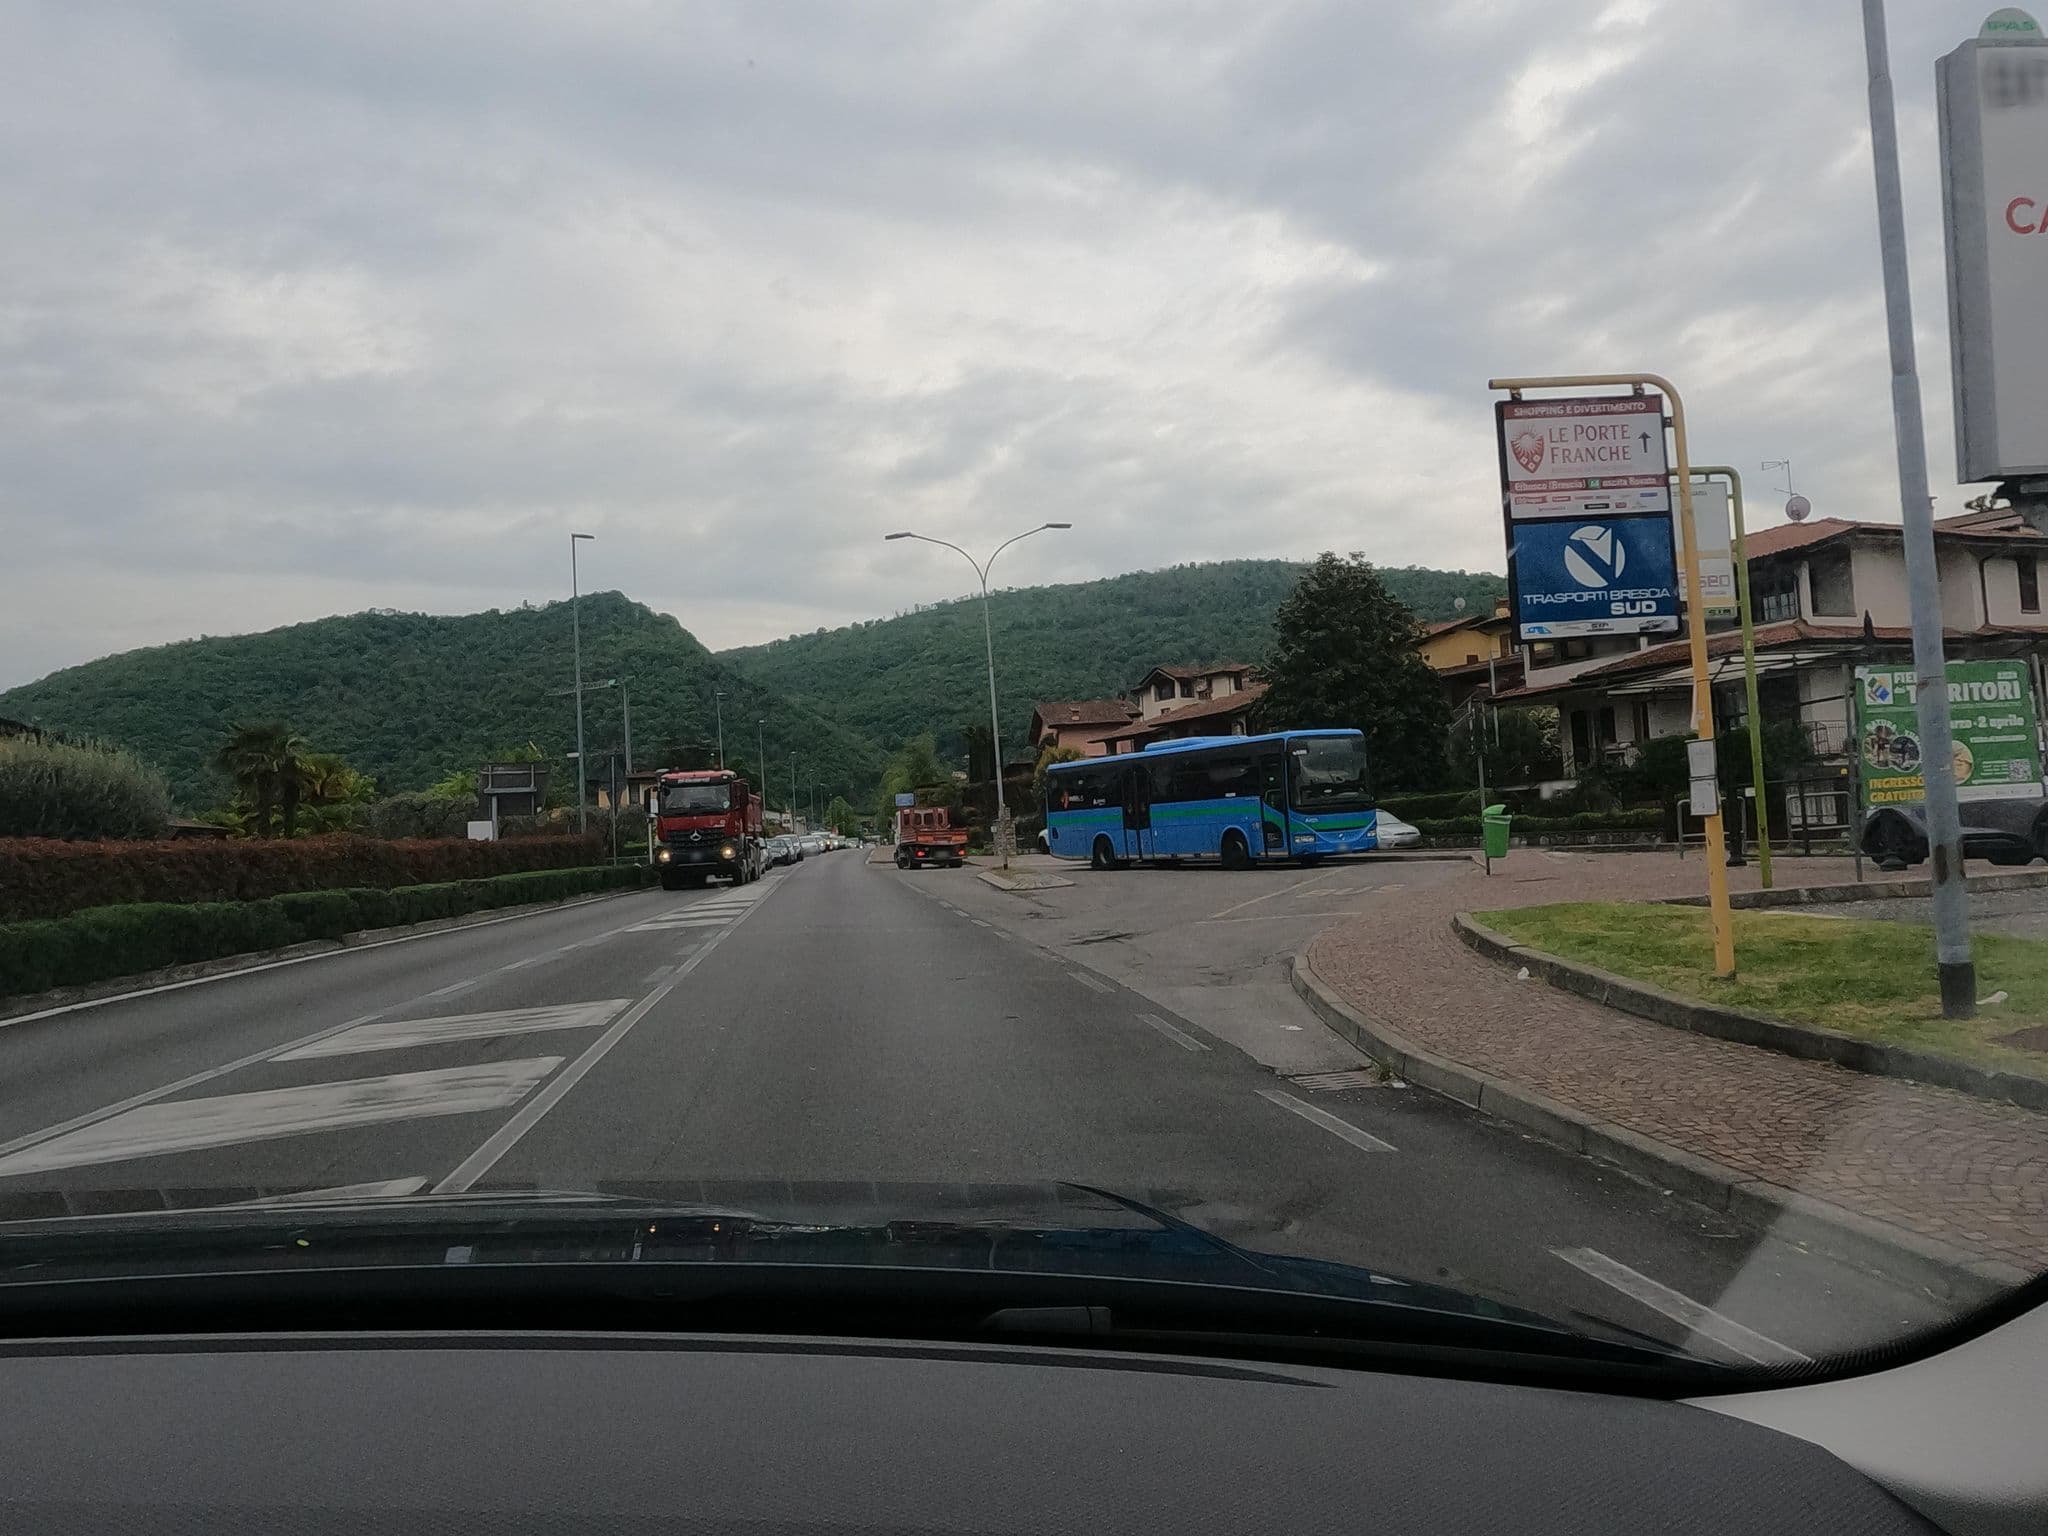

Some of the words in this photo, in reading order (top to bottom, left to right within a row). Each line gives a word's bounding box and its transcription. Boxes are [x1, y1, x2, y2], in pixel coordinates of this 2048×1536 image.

[1514, 406, 1564, 417] SHOPPING
[1566, 405, 1573, 414] E
[1574, 402, 1647, 414] DIVERTIMENTO
[1549, 427, 1568, 443] LE
[1574, 423, 1631, 441] PORTE
[1551, 446, 1632, 464] FRANCHE
[1523, 591, 1607, 605] TRASPORTI
[1610, 588, 1671, 600] BRESCIA
[1610, 600, 1657, 615] SUD
